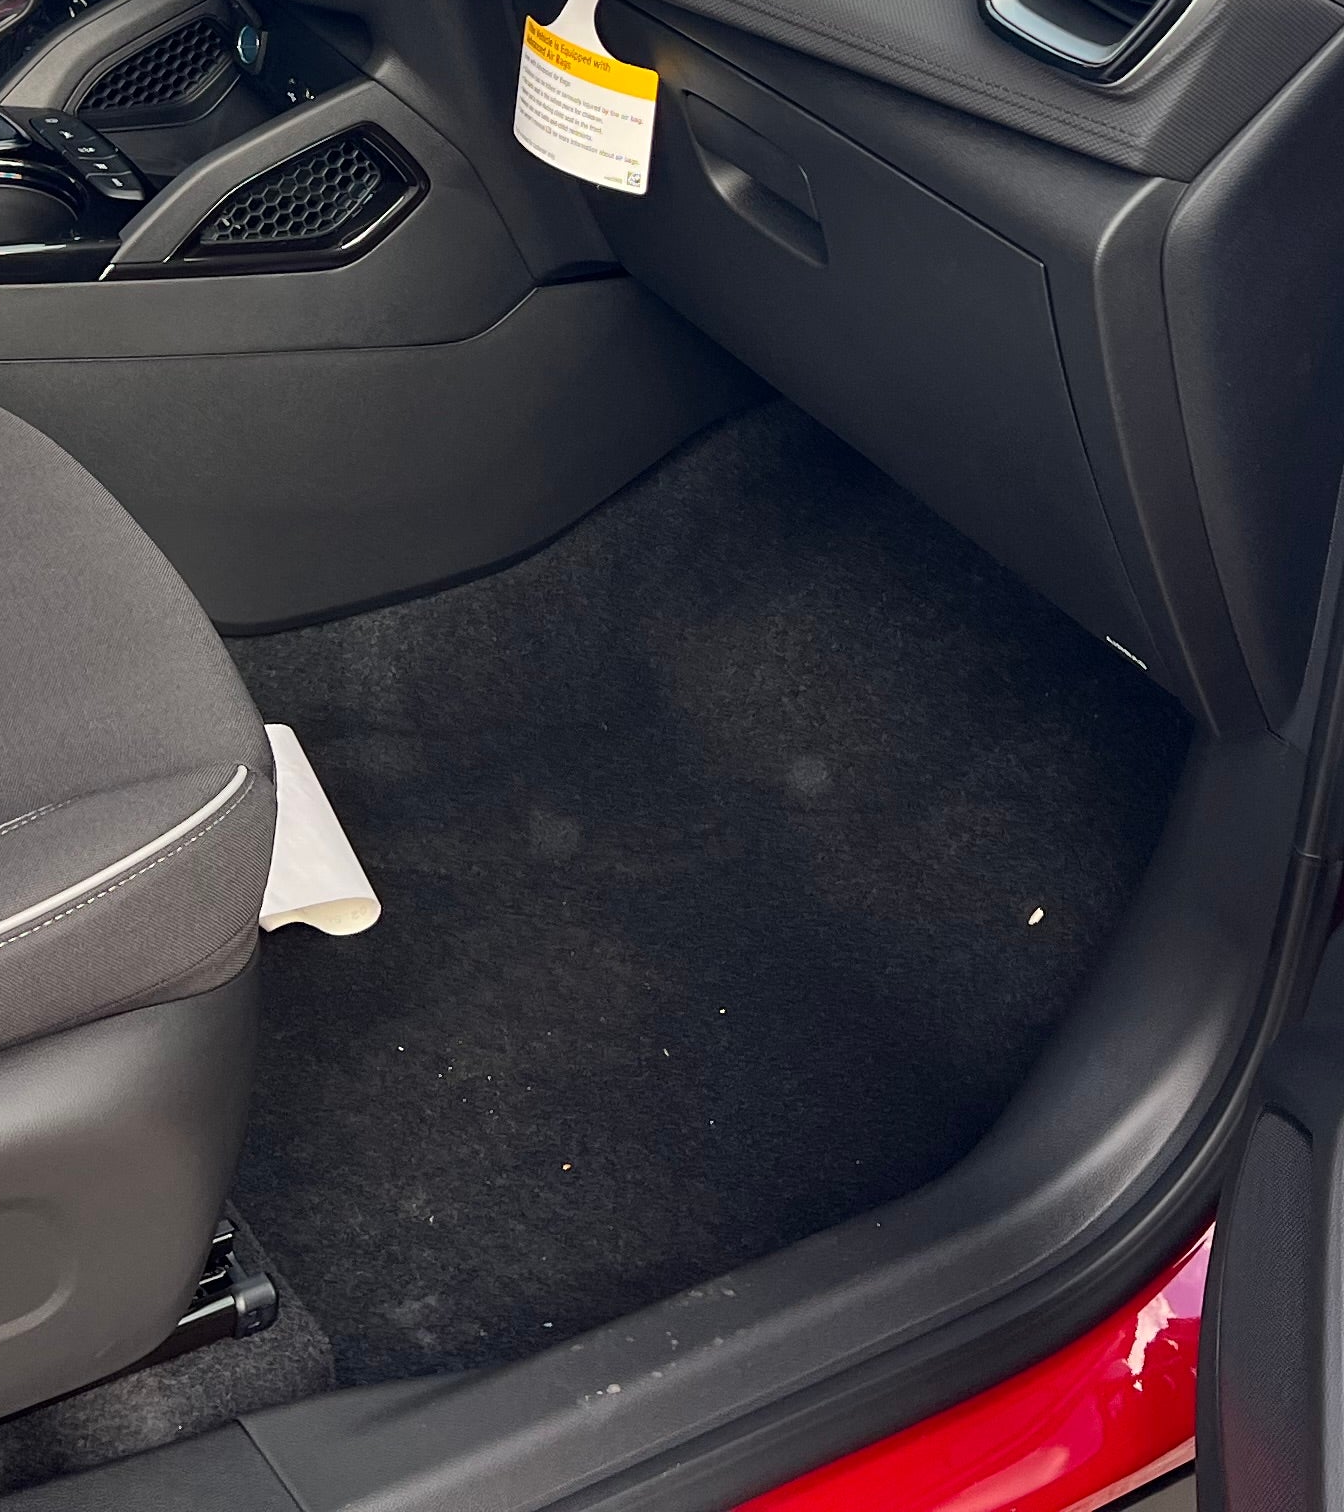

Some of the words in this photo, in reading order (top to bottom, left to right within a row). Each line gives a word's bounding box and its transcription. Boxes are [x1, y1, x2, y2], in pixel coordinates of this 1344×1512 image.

[556, 54, 572, 71] Bags
[560, 43, 592, 65] Equipped
[593, 60, 611, 72] with
